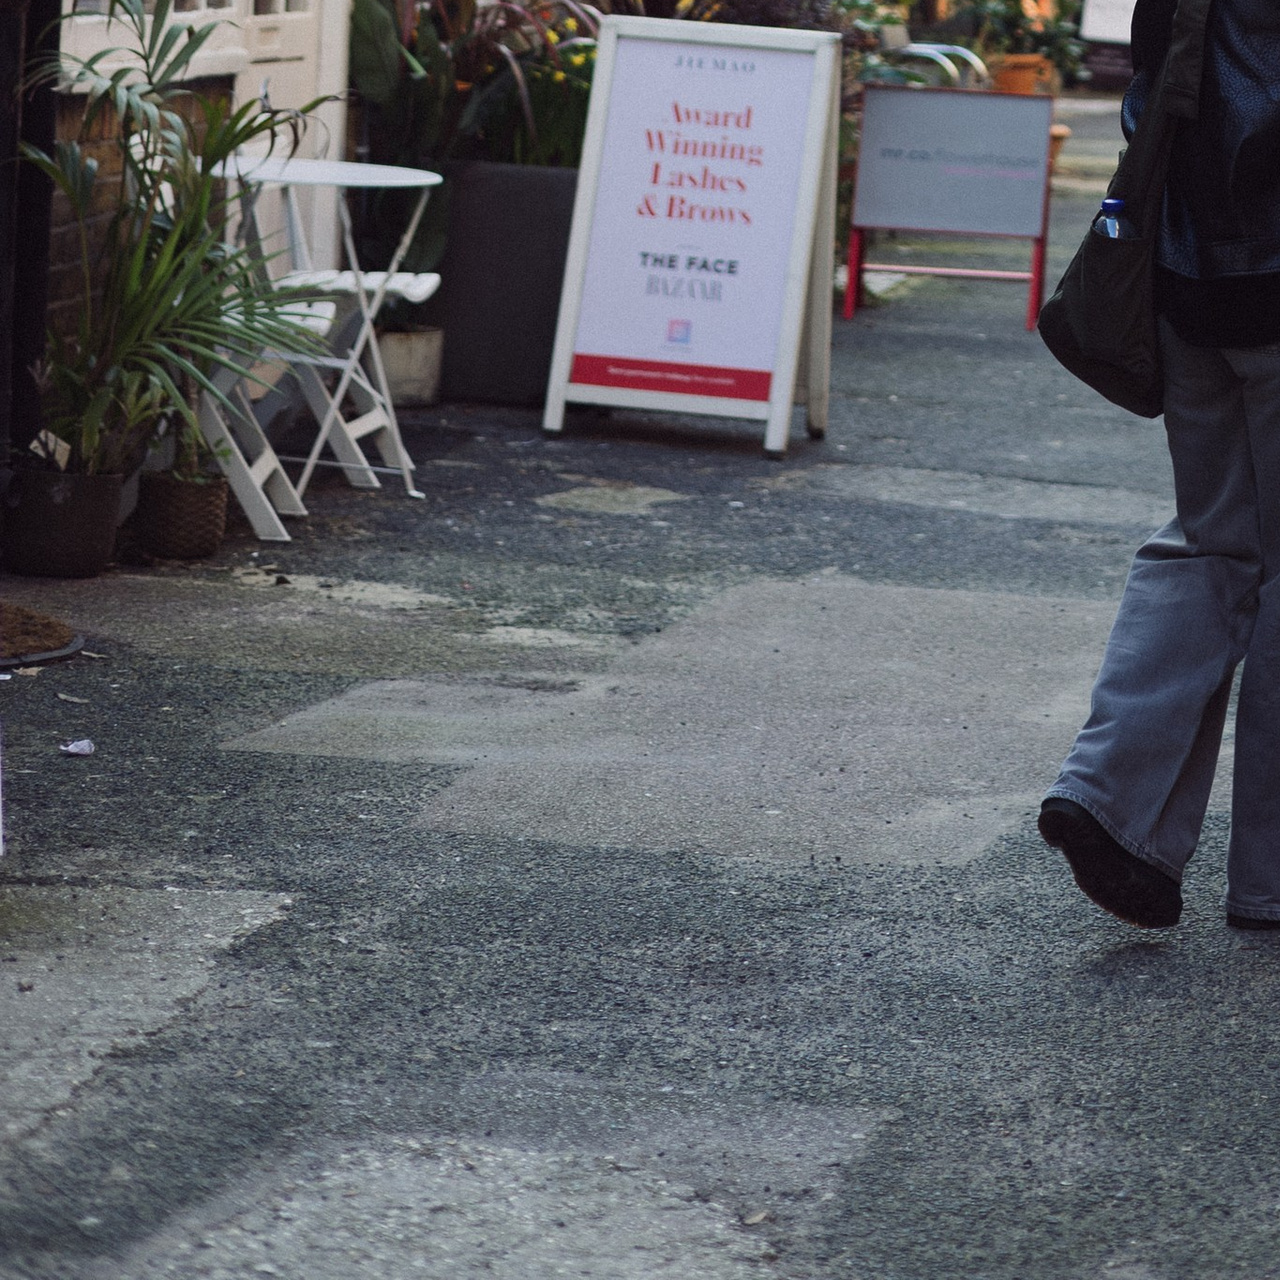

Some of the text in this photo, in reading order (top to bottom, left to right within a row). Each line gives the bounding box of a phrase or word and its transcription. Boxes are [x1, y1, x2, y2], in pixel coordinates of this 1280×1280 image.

[663, 101, 752, 130] Award
[645, 128, 764, 167] Winning
[651, 161, 748, 192] Lashes
[636, 193, 753, 225] & Brows
[639, 251, 740, 276] THE FACE
